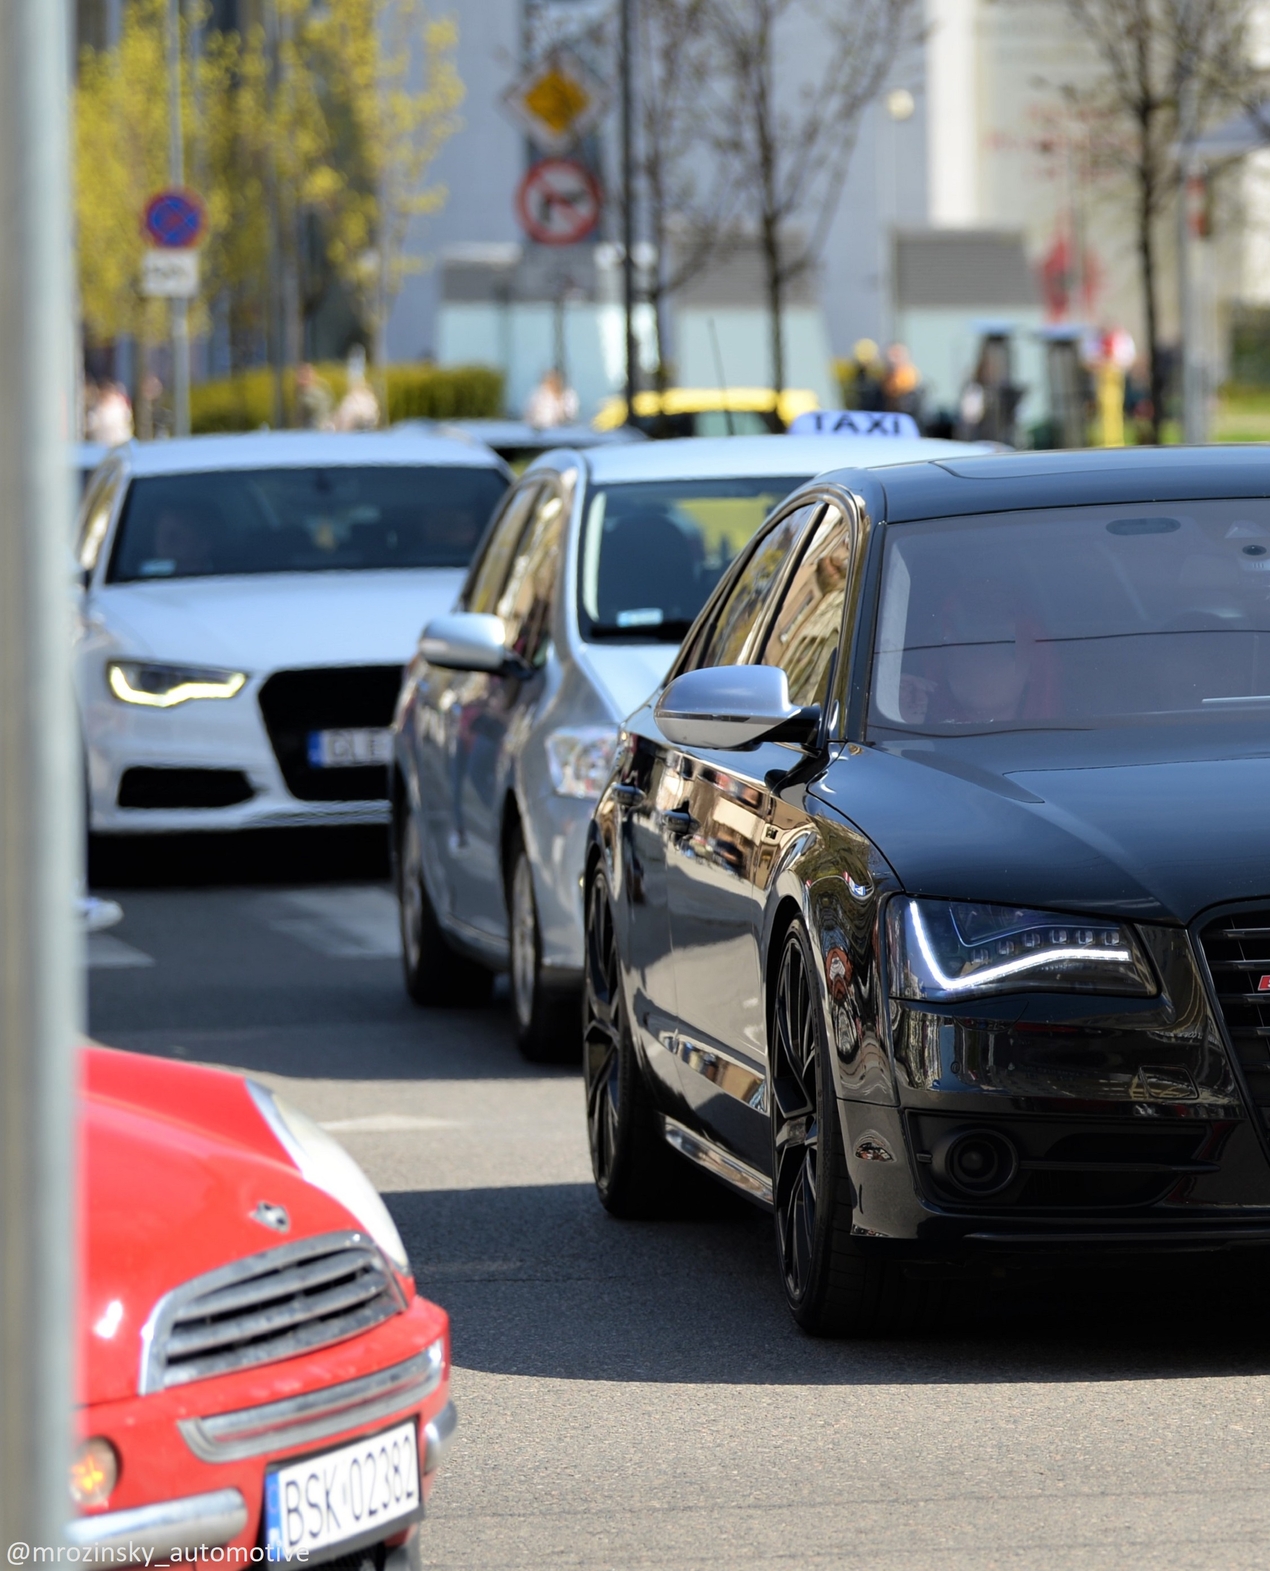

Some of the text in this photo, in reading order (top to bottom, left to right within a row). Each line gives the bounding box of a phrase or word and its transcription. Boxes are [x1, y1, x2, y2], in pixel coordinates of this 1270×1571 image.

[812, 413, 902, 434] TAXI
[285, 1434, 414, 1547] BSK 02382
